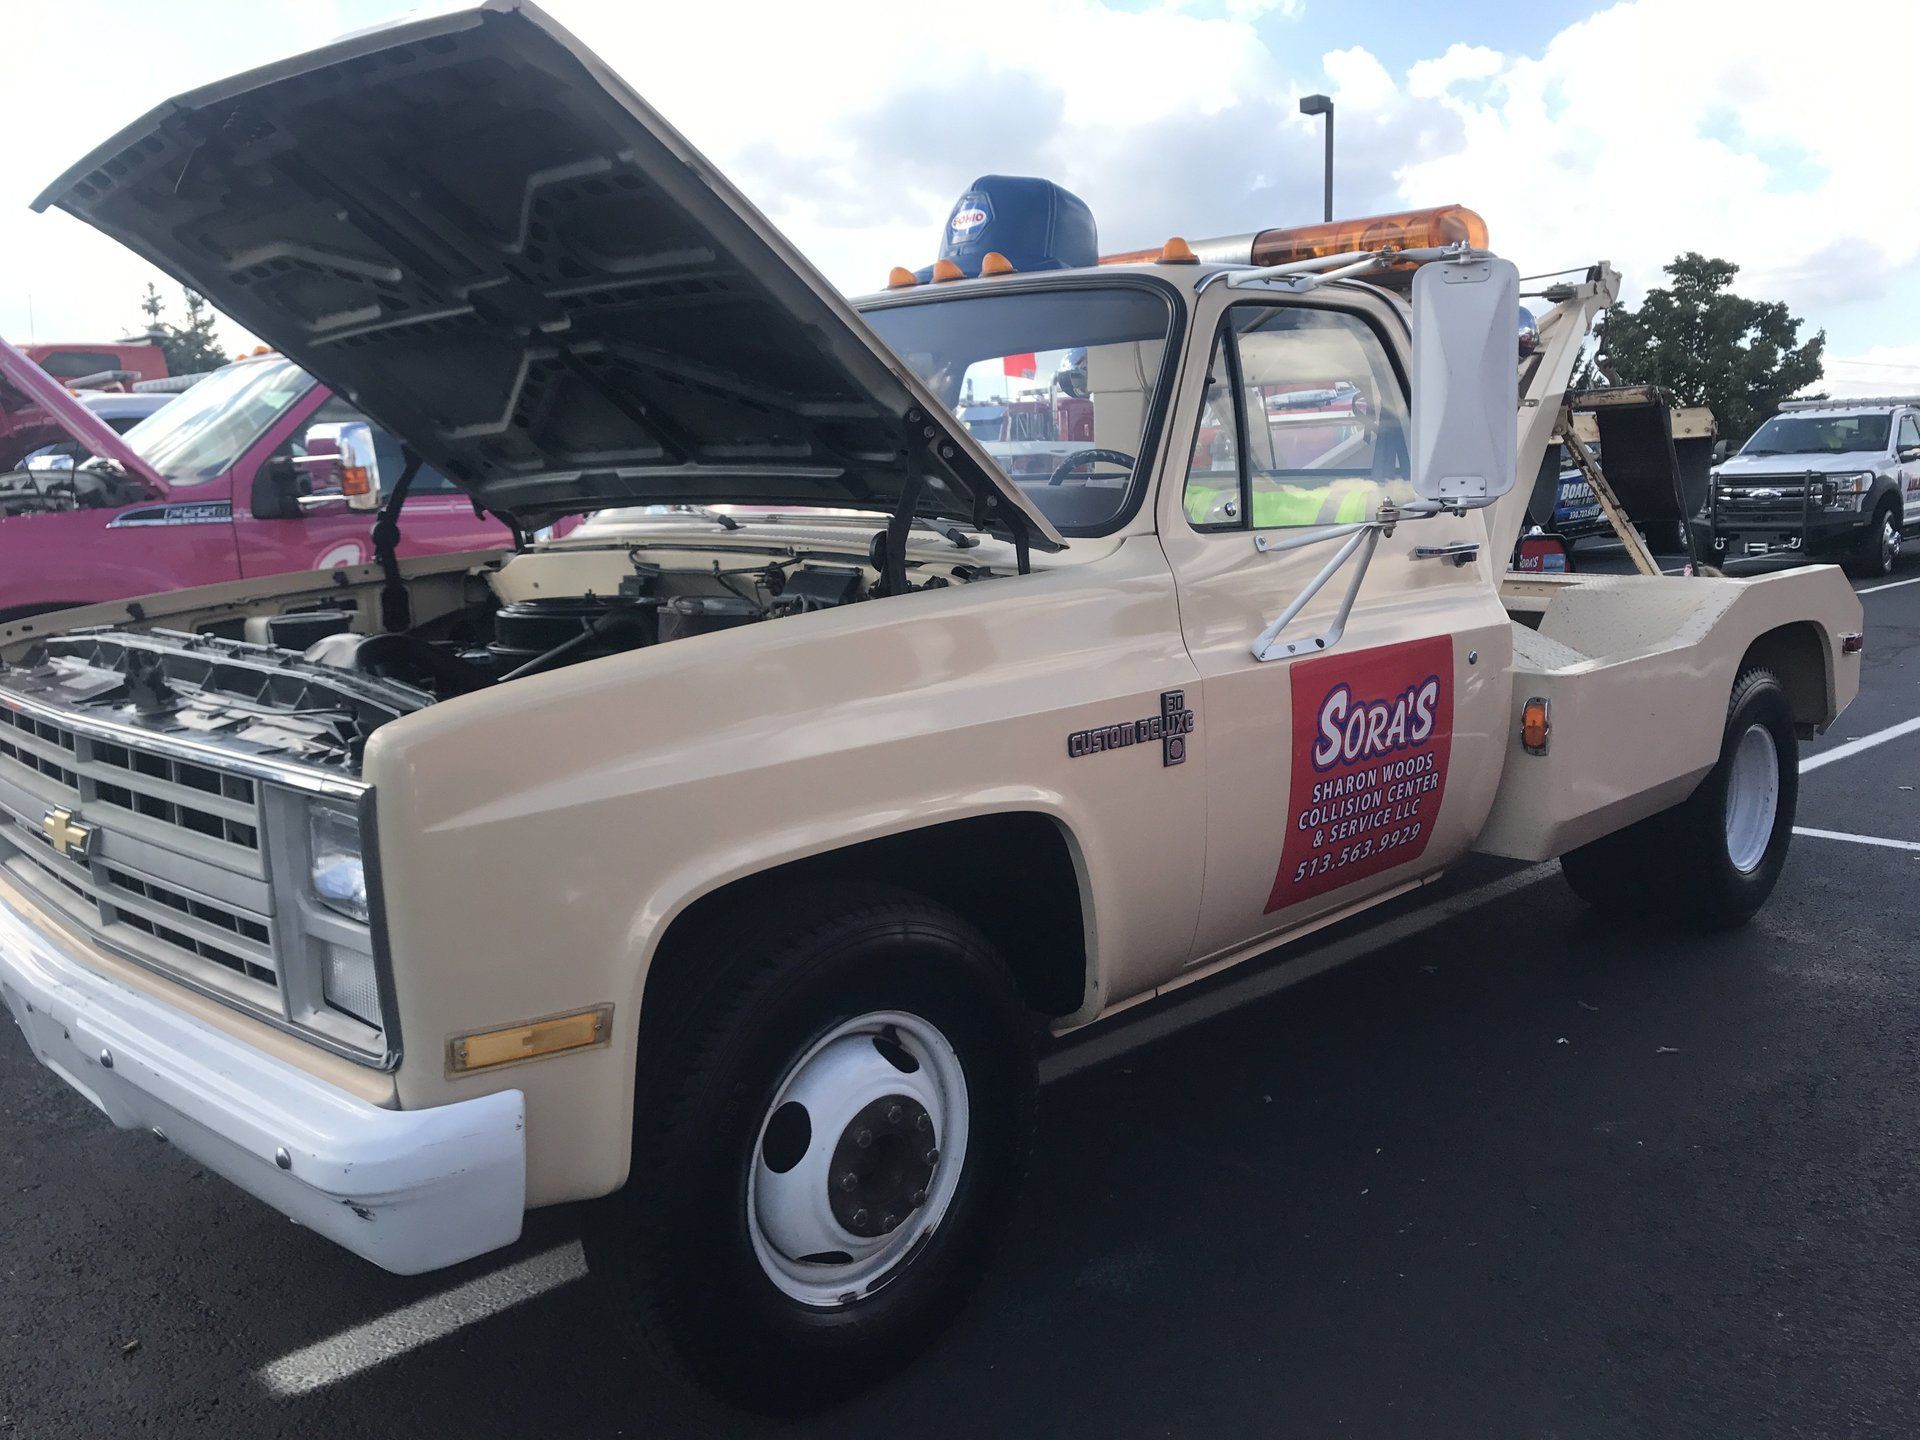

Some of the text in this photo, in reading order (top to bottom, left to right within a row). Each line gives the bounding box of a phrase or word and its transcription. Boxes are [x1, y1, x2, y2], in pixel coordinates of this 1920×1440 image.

[1069, 710, 1194, 757] CUSTOM DELUXE
[1314, 680, 1438, 767] SORA'S
[1299, 772, 1439, 830] COLLISION CENTER
[1313, 753, 1433, 803] SHARON WOODS
[1313, 798, 1421, 848] & SERVICE LLC
[1294, 822, 1421, 882] 513.563.9929
